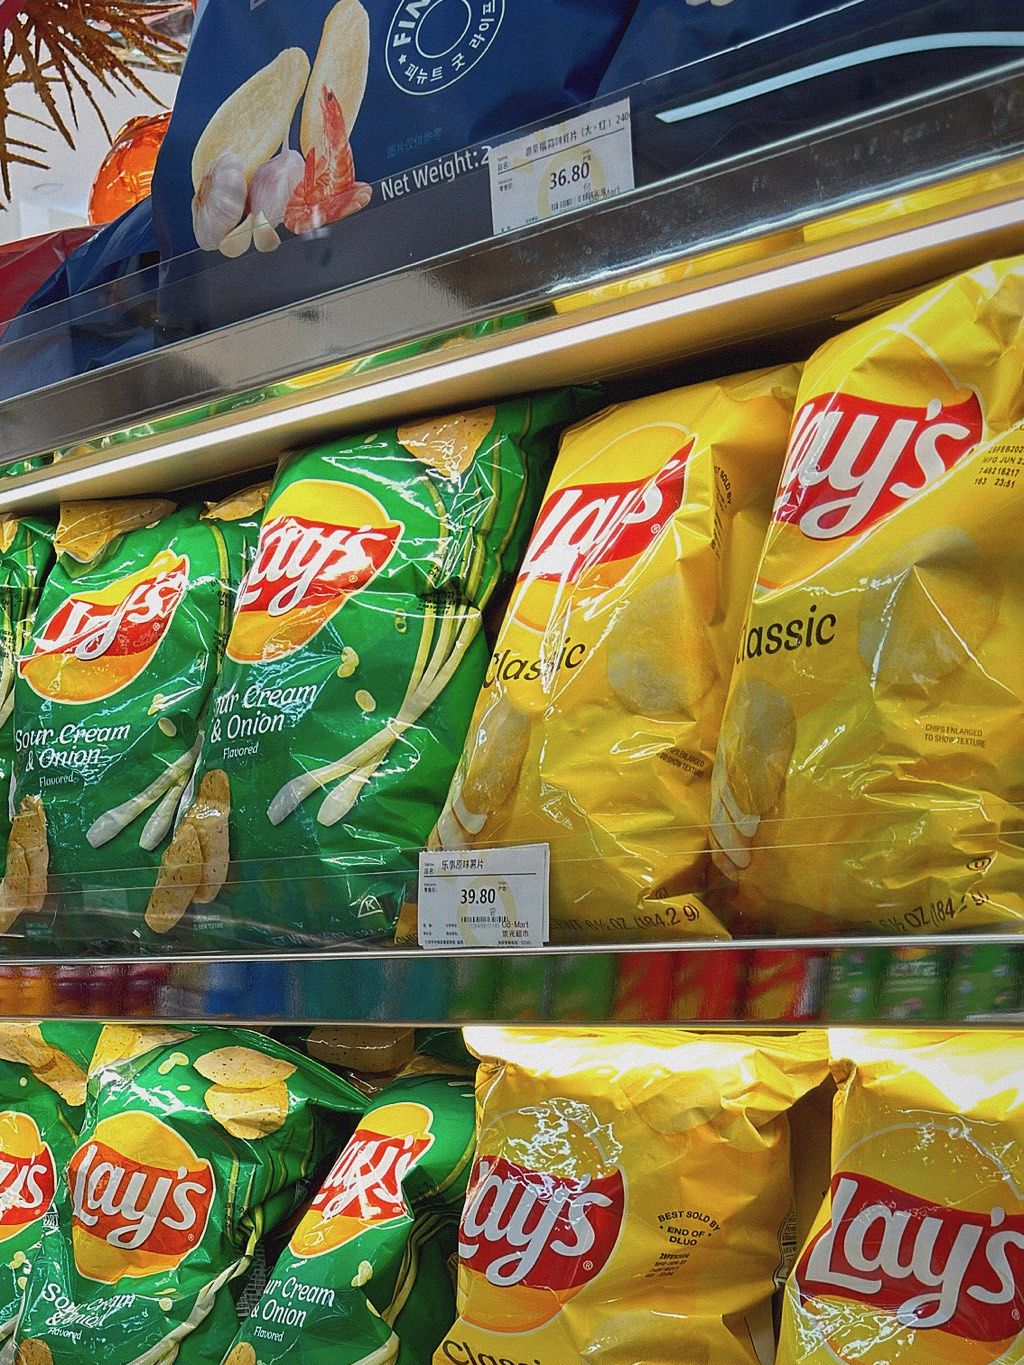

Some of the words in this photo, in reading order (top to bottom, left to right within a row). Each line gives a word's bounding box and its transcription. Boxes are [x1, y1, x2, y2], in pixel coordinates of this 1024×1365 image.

[405, 64, 444, 84] 피뉴트
[451, 53, 466, 71] 굿
[549, 161, 590, 190] 36.80
[380, 178, 409, 201] Net
[244, 684, 318, 709] Cream
[16, 728, 54, 752] Sour
[60, 723, 131, 746] Cream
[210, 721, 222, 744] &
[226, 712, 285, 740] Onion
[925, 724, 947, 735] CHIPS
[947, 726, 983, 738] ENLARGED
[223, 743, 259, 760] Flavored
[925, 733, 934, 742] TO
[934, 734, 958, 745] SHOW
[957, 736, 987, 749] TEXTURE
[26, 754, 34, 772] &
[39, 746, 100, 769] Onion
[39, 773, 75, 788] Flavored
[441, 859, 484, 871] 乐事原味薯片
[460, 888, 496, 905] 39.80
[72, 1144, 207, 1250] Lay's
[657, 1210, 685, 1223] BEST
[685, 1210, 711, 1223] SOLD
[709, 1220, 721, 1232] BY
[666, 1226, 689, 1237] END
[691, 1230, 706, 1238] OF
[669, 1235, 698, 1246] DLUO
[805, 1177, 1024, 1328] Lay's
[282, 1275, 336, 1307] Cream
[250, 1303, 260, 1318] &
[262, 1299, 307, 1328] Onion
[46, 1326, 82, 1341] Flavored
[253, 1325, 284, 1343] Flavored
